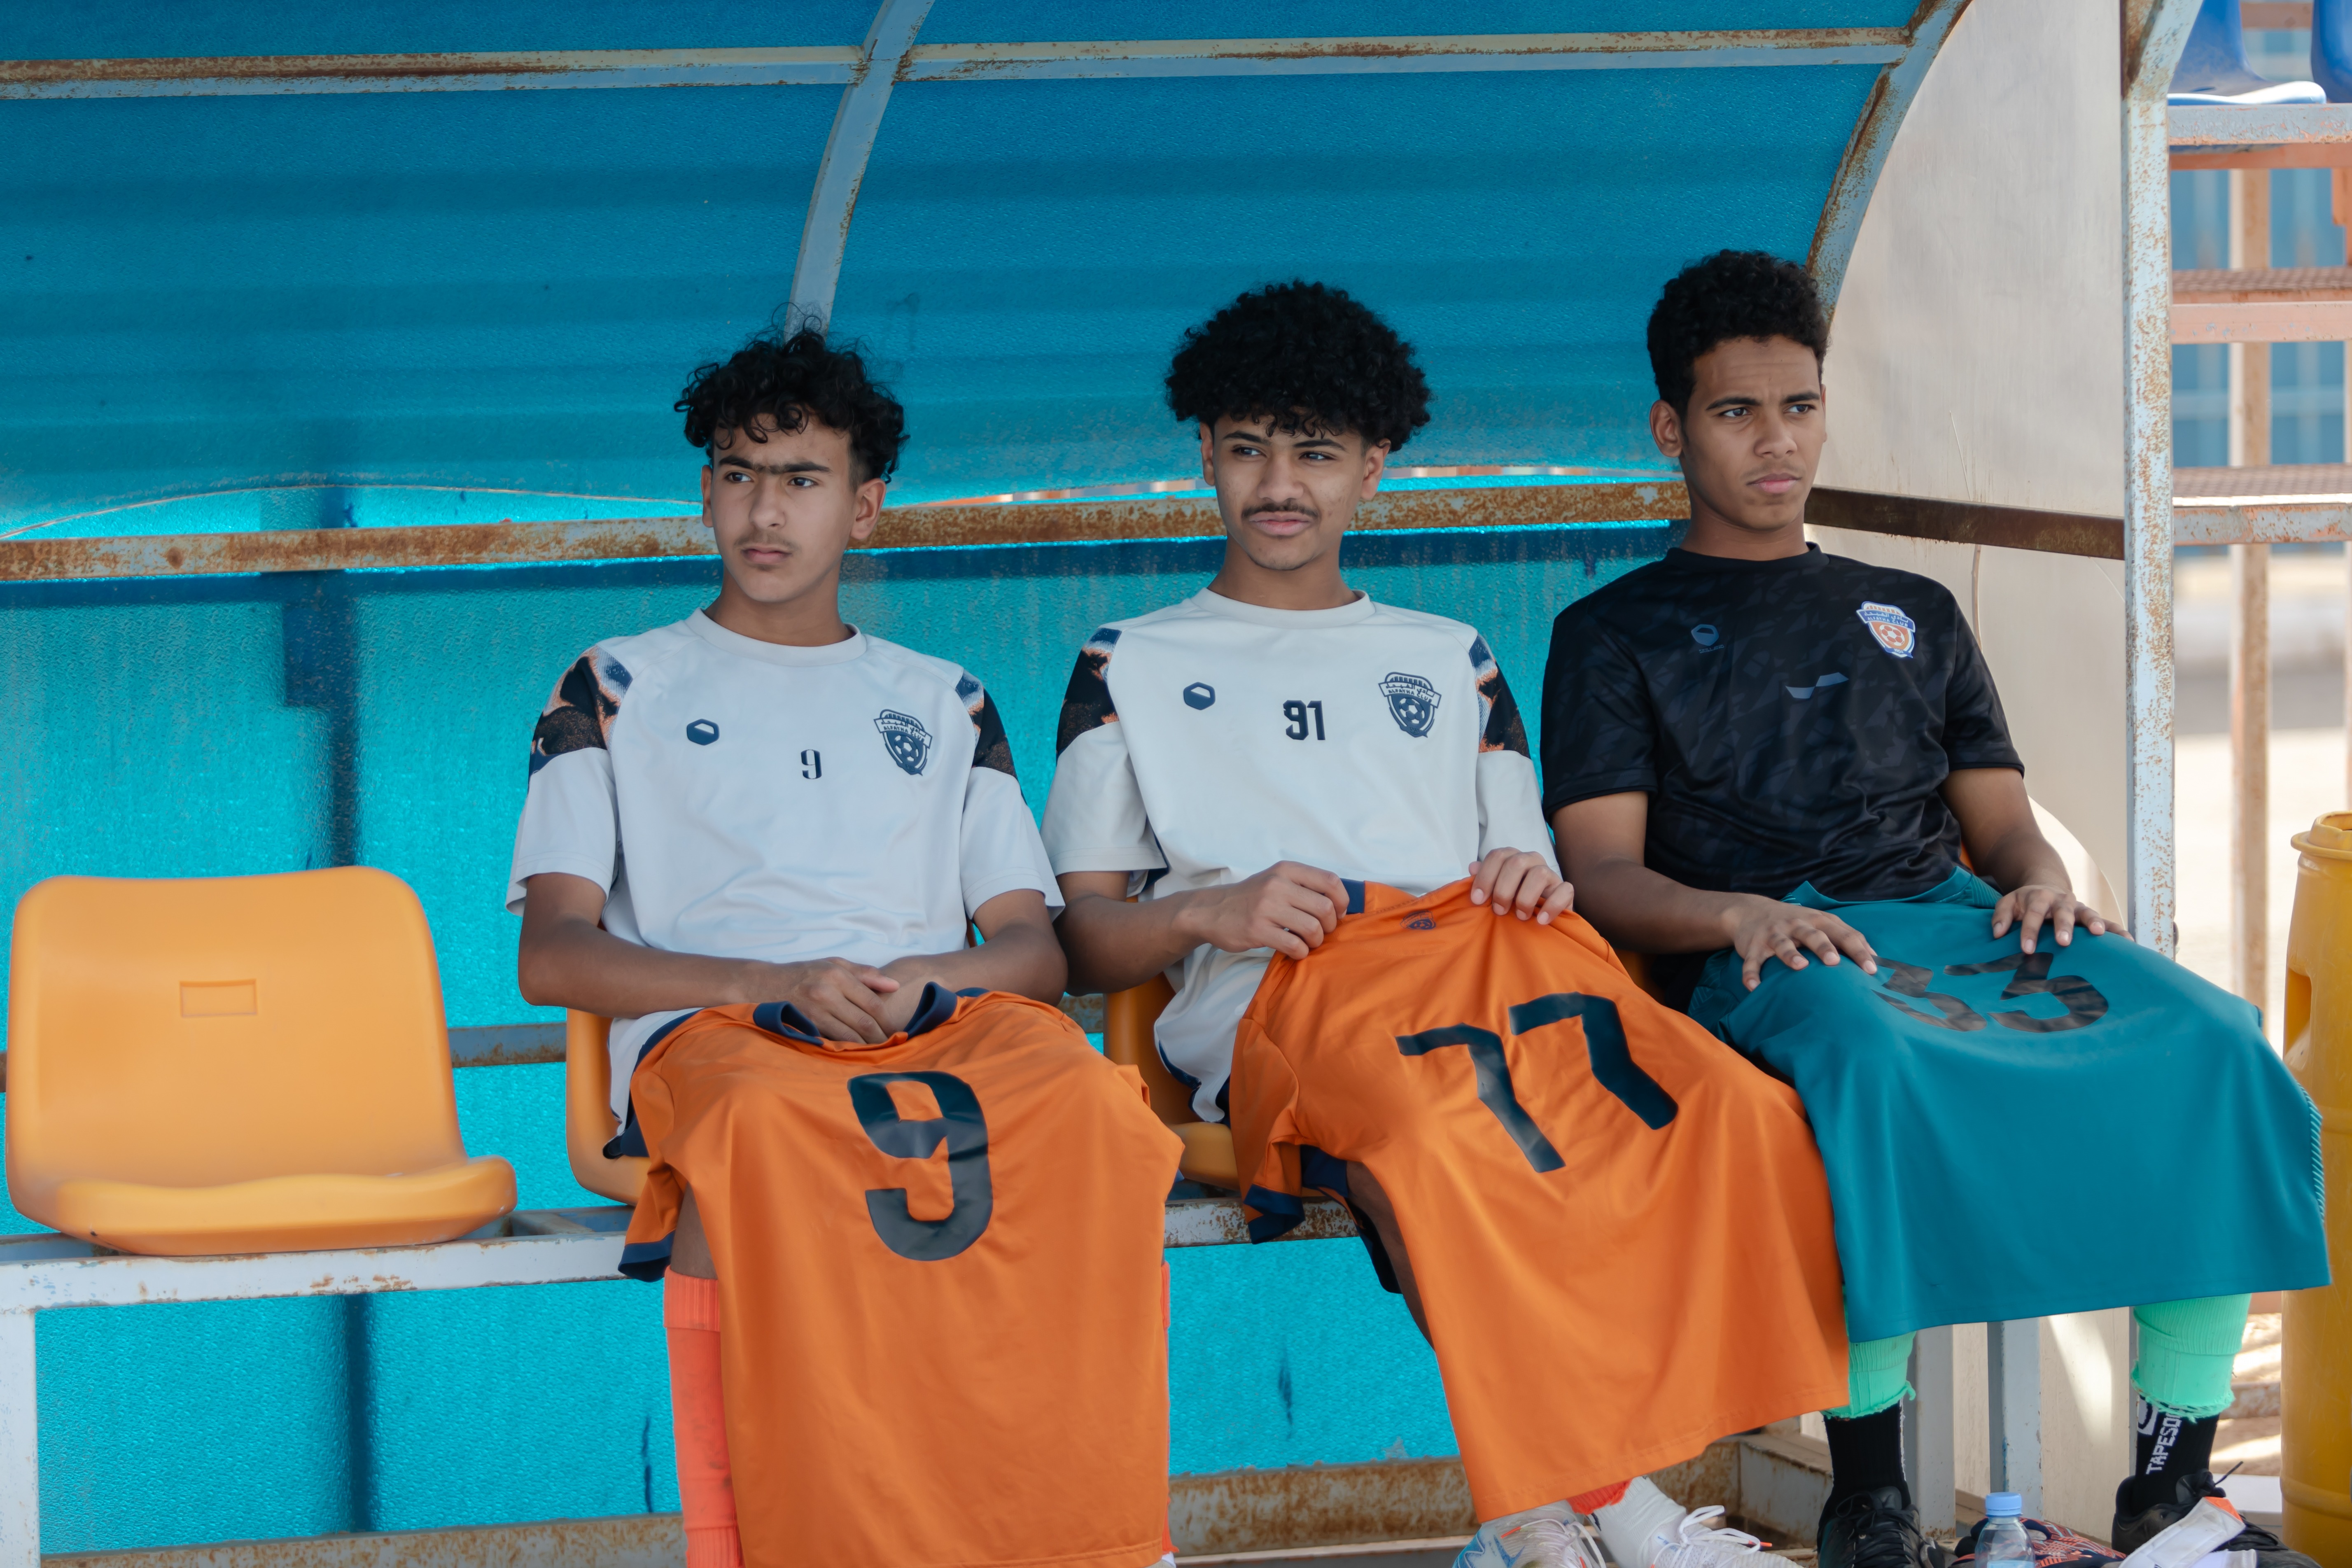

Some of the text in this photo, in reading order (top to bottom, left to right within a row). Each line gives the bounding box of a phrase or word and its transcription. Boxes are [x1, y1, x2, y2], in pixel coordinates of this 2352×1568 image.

[1417, 692, 1432, 702] CLUB
[1283, 700, 1325, 740] 91
[800, 749, 822, 779] 9
[1395, 991, 1679, 1173] 77
[847, 1071, 994, 1261] 9
